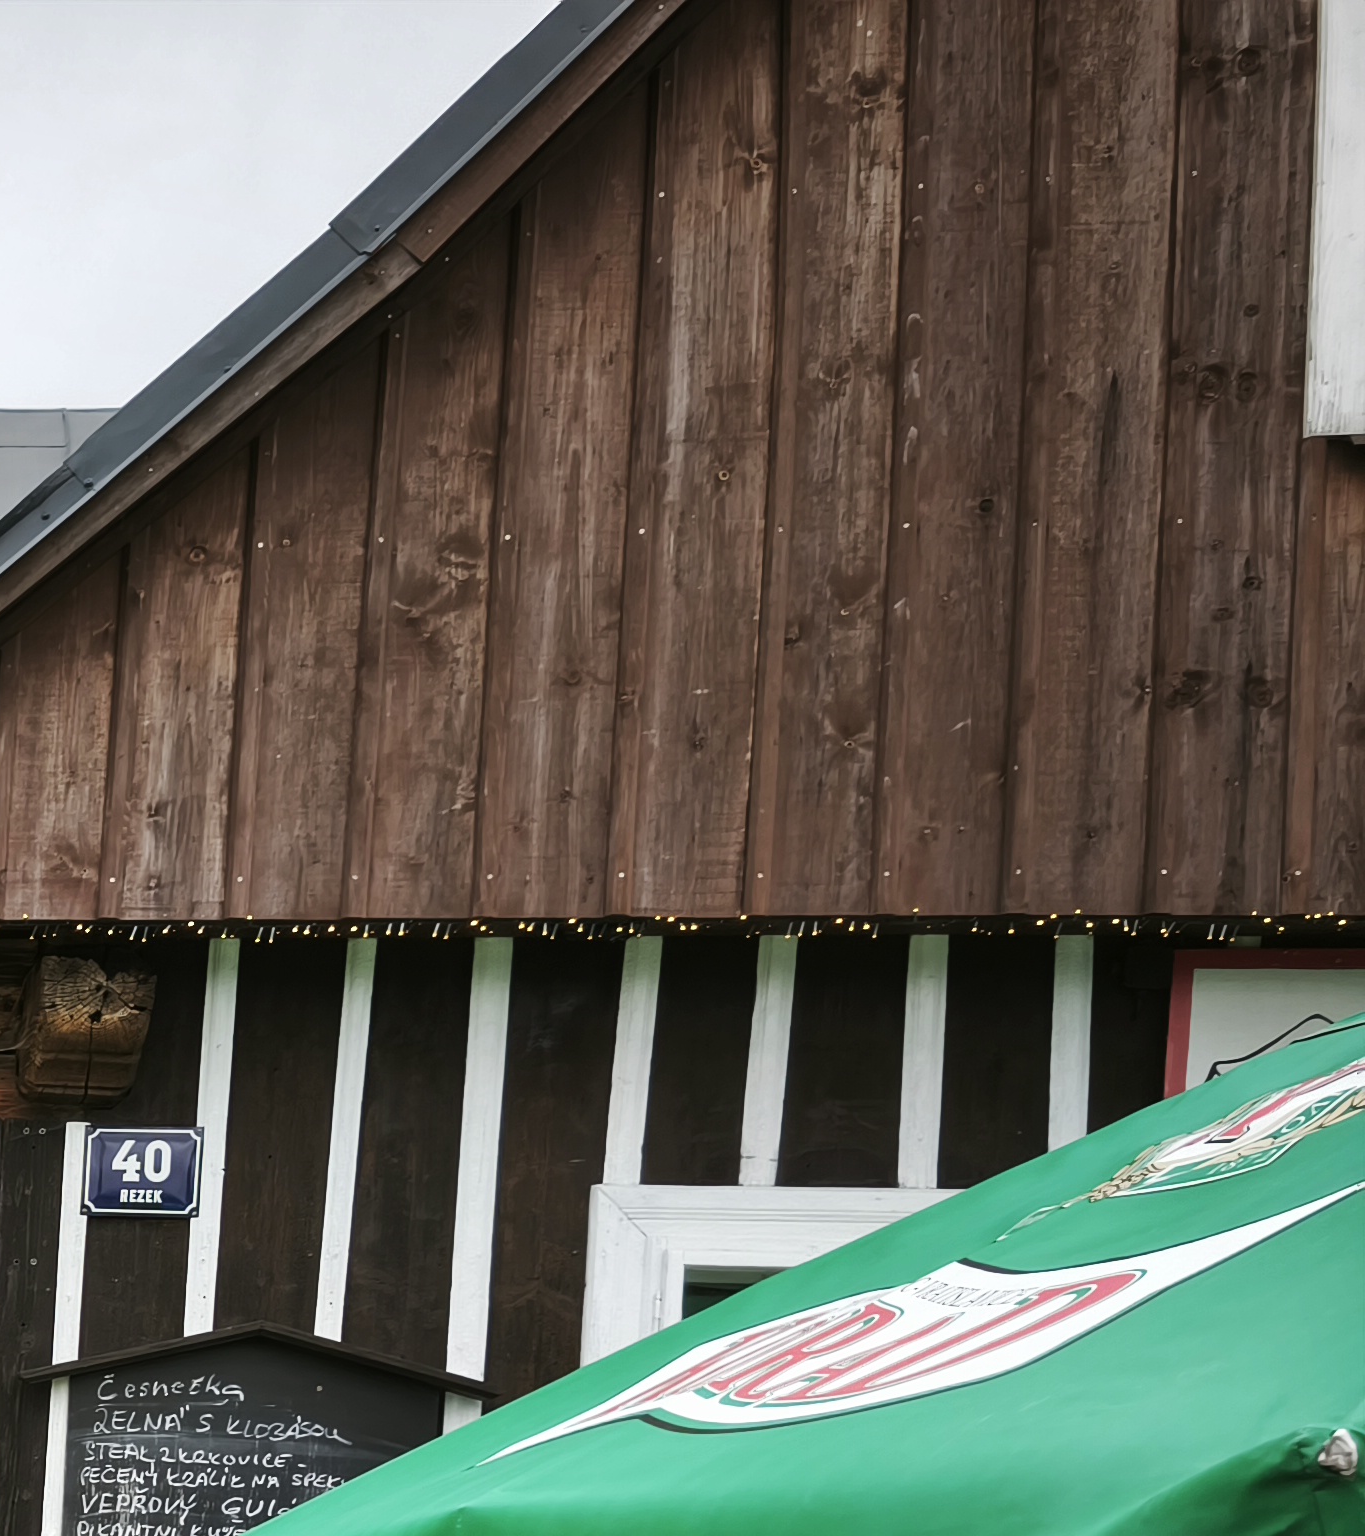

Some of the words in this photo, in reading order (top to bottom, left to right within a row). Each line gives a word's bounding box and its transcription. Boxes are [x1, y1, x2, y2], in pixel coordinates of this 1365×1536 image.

[111, 1139, 172, 1183] 40
[119, 1189, 163, 1203] REZEK
[196, 1413, 215, 1433] S
[84, 1441, 156, 1463] STEAK
[251, 1473, 280, 1489] NA
